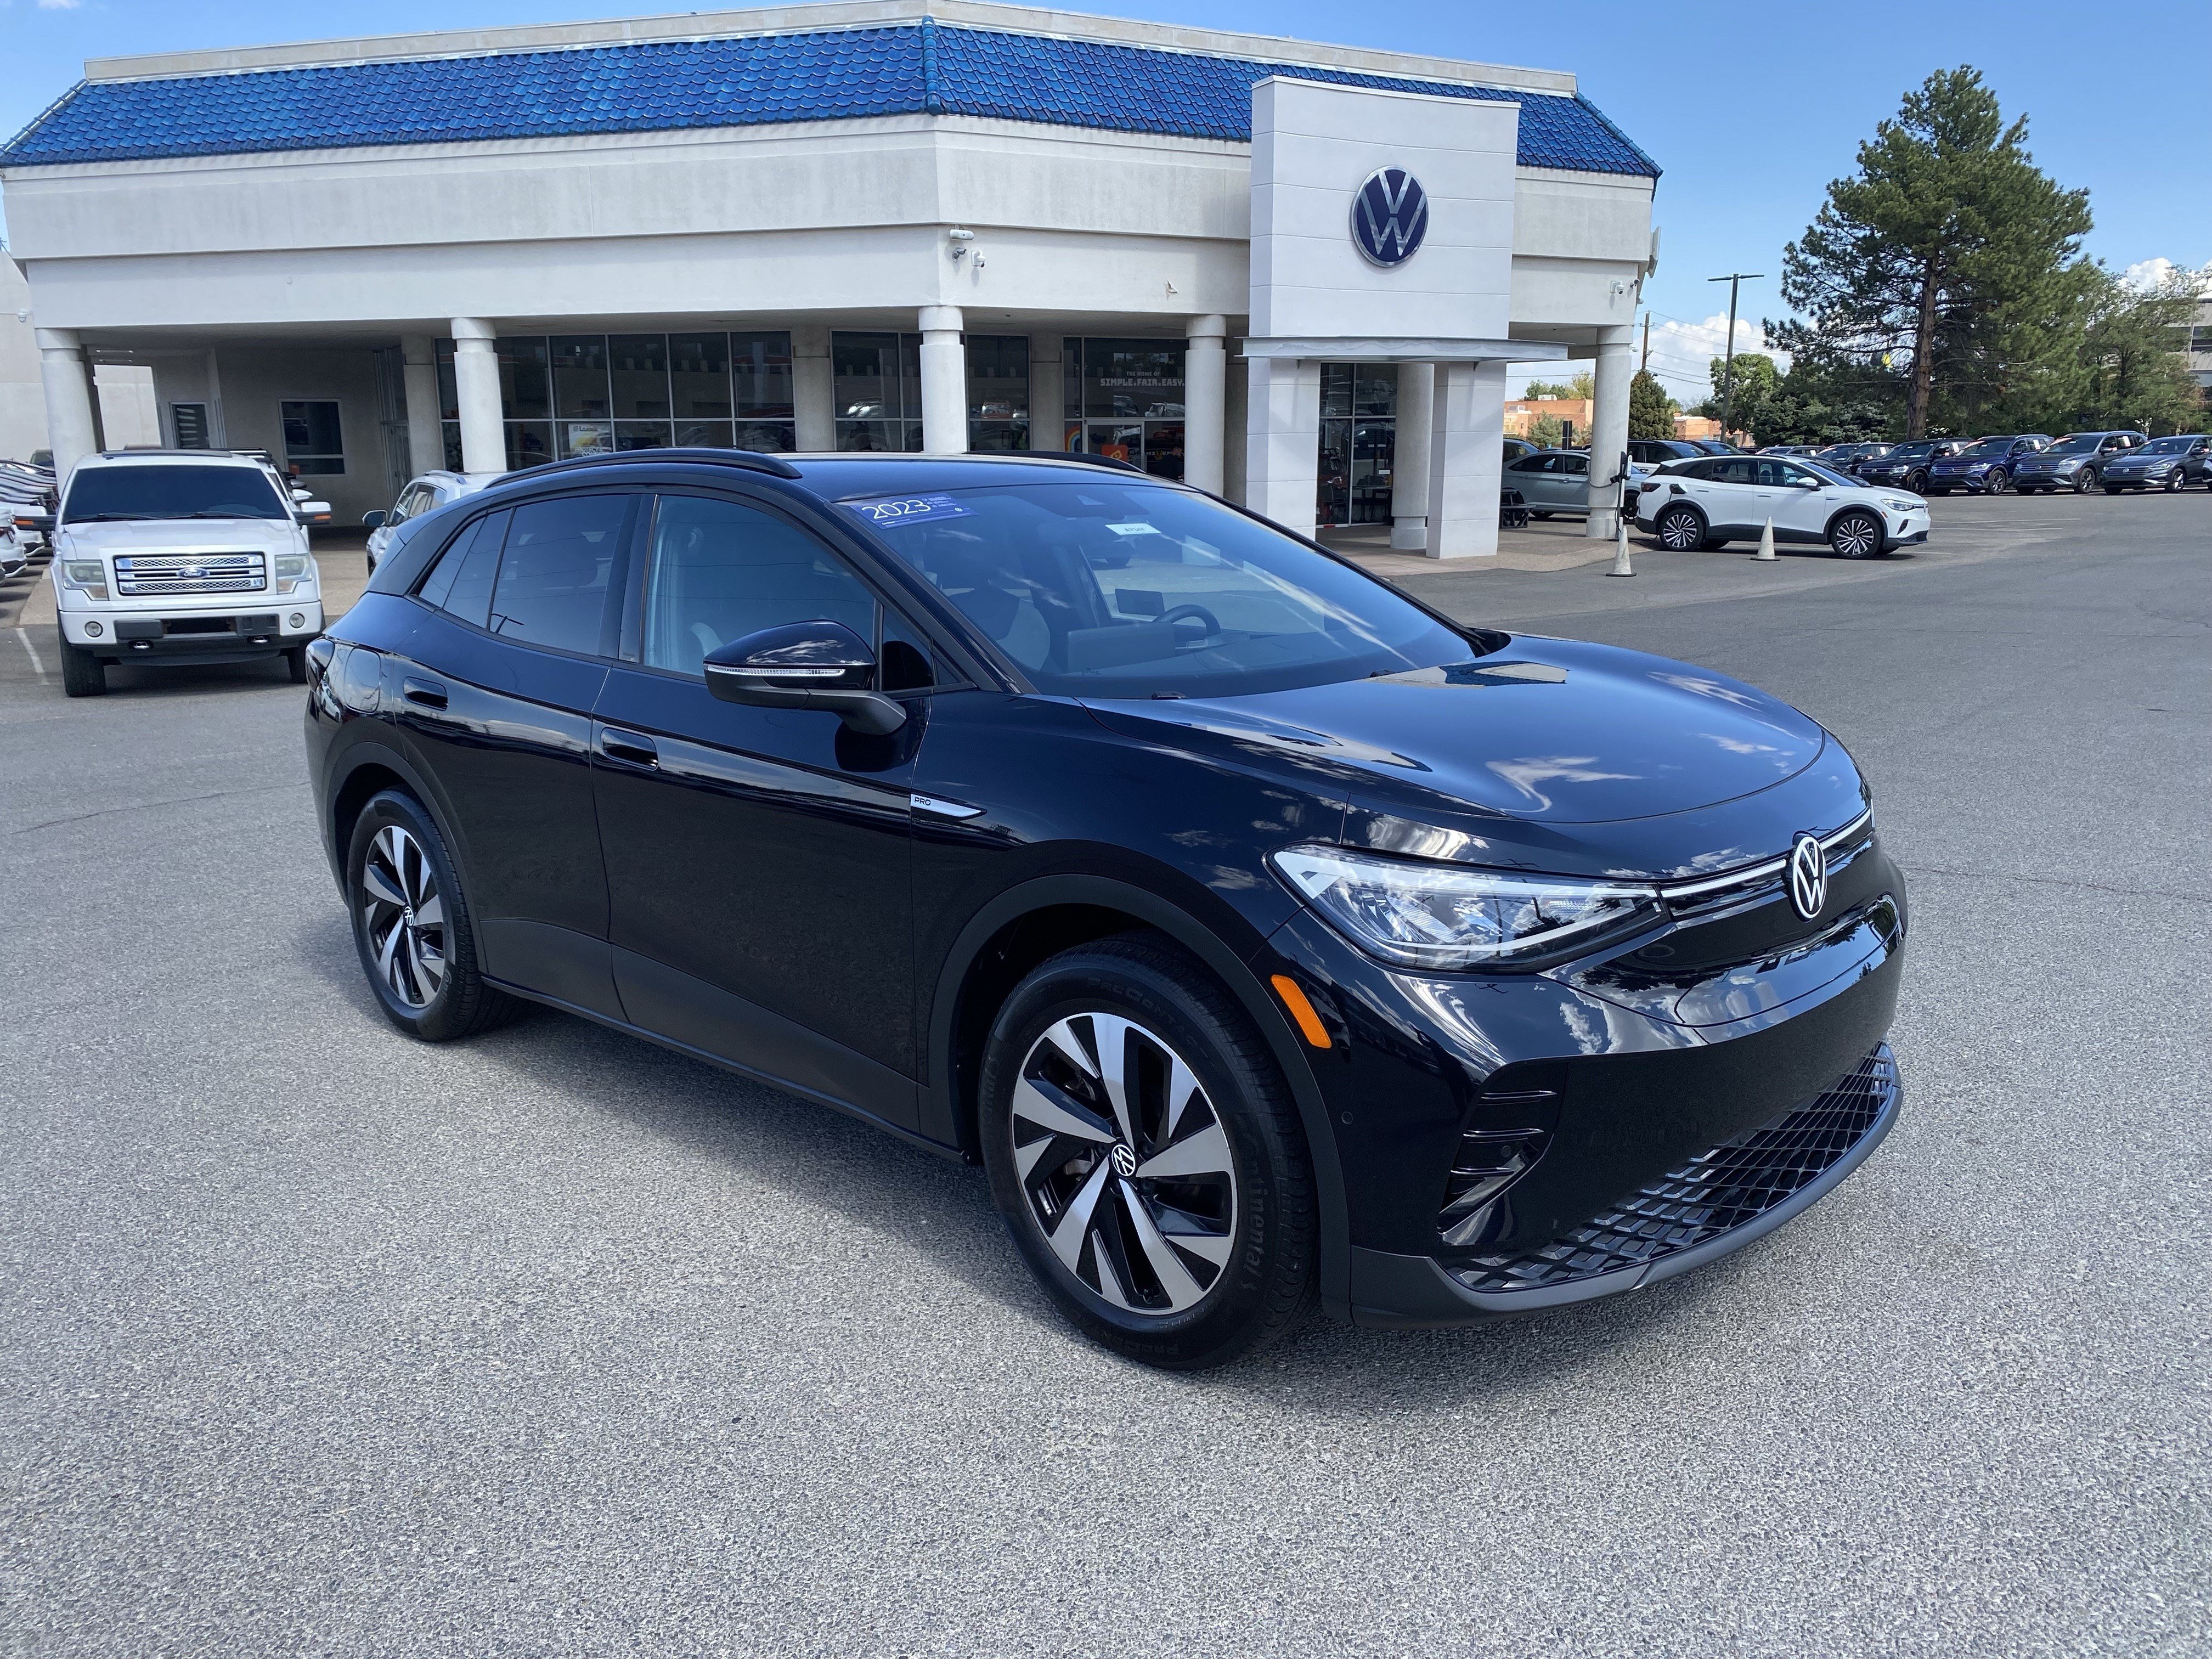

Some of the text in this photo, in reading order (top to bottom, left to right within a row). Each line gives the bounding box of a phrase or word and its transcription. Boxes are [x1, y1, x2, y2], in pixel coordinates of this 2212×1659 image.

[1355, 167, 1427, 258] VW
[861, 500, 931, 519] 2023
[914, 797, 931, 806] PRO
